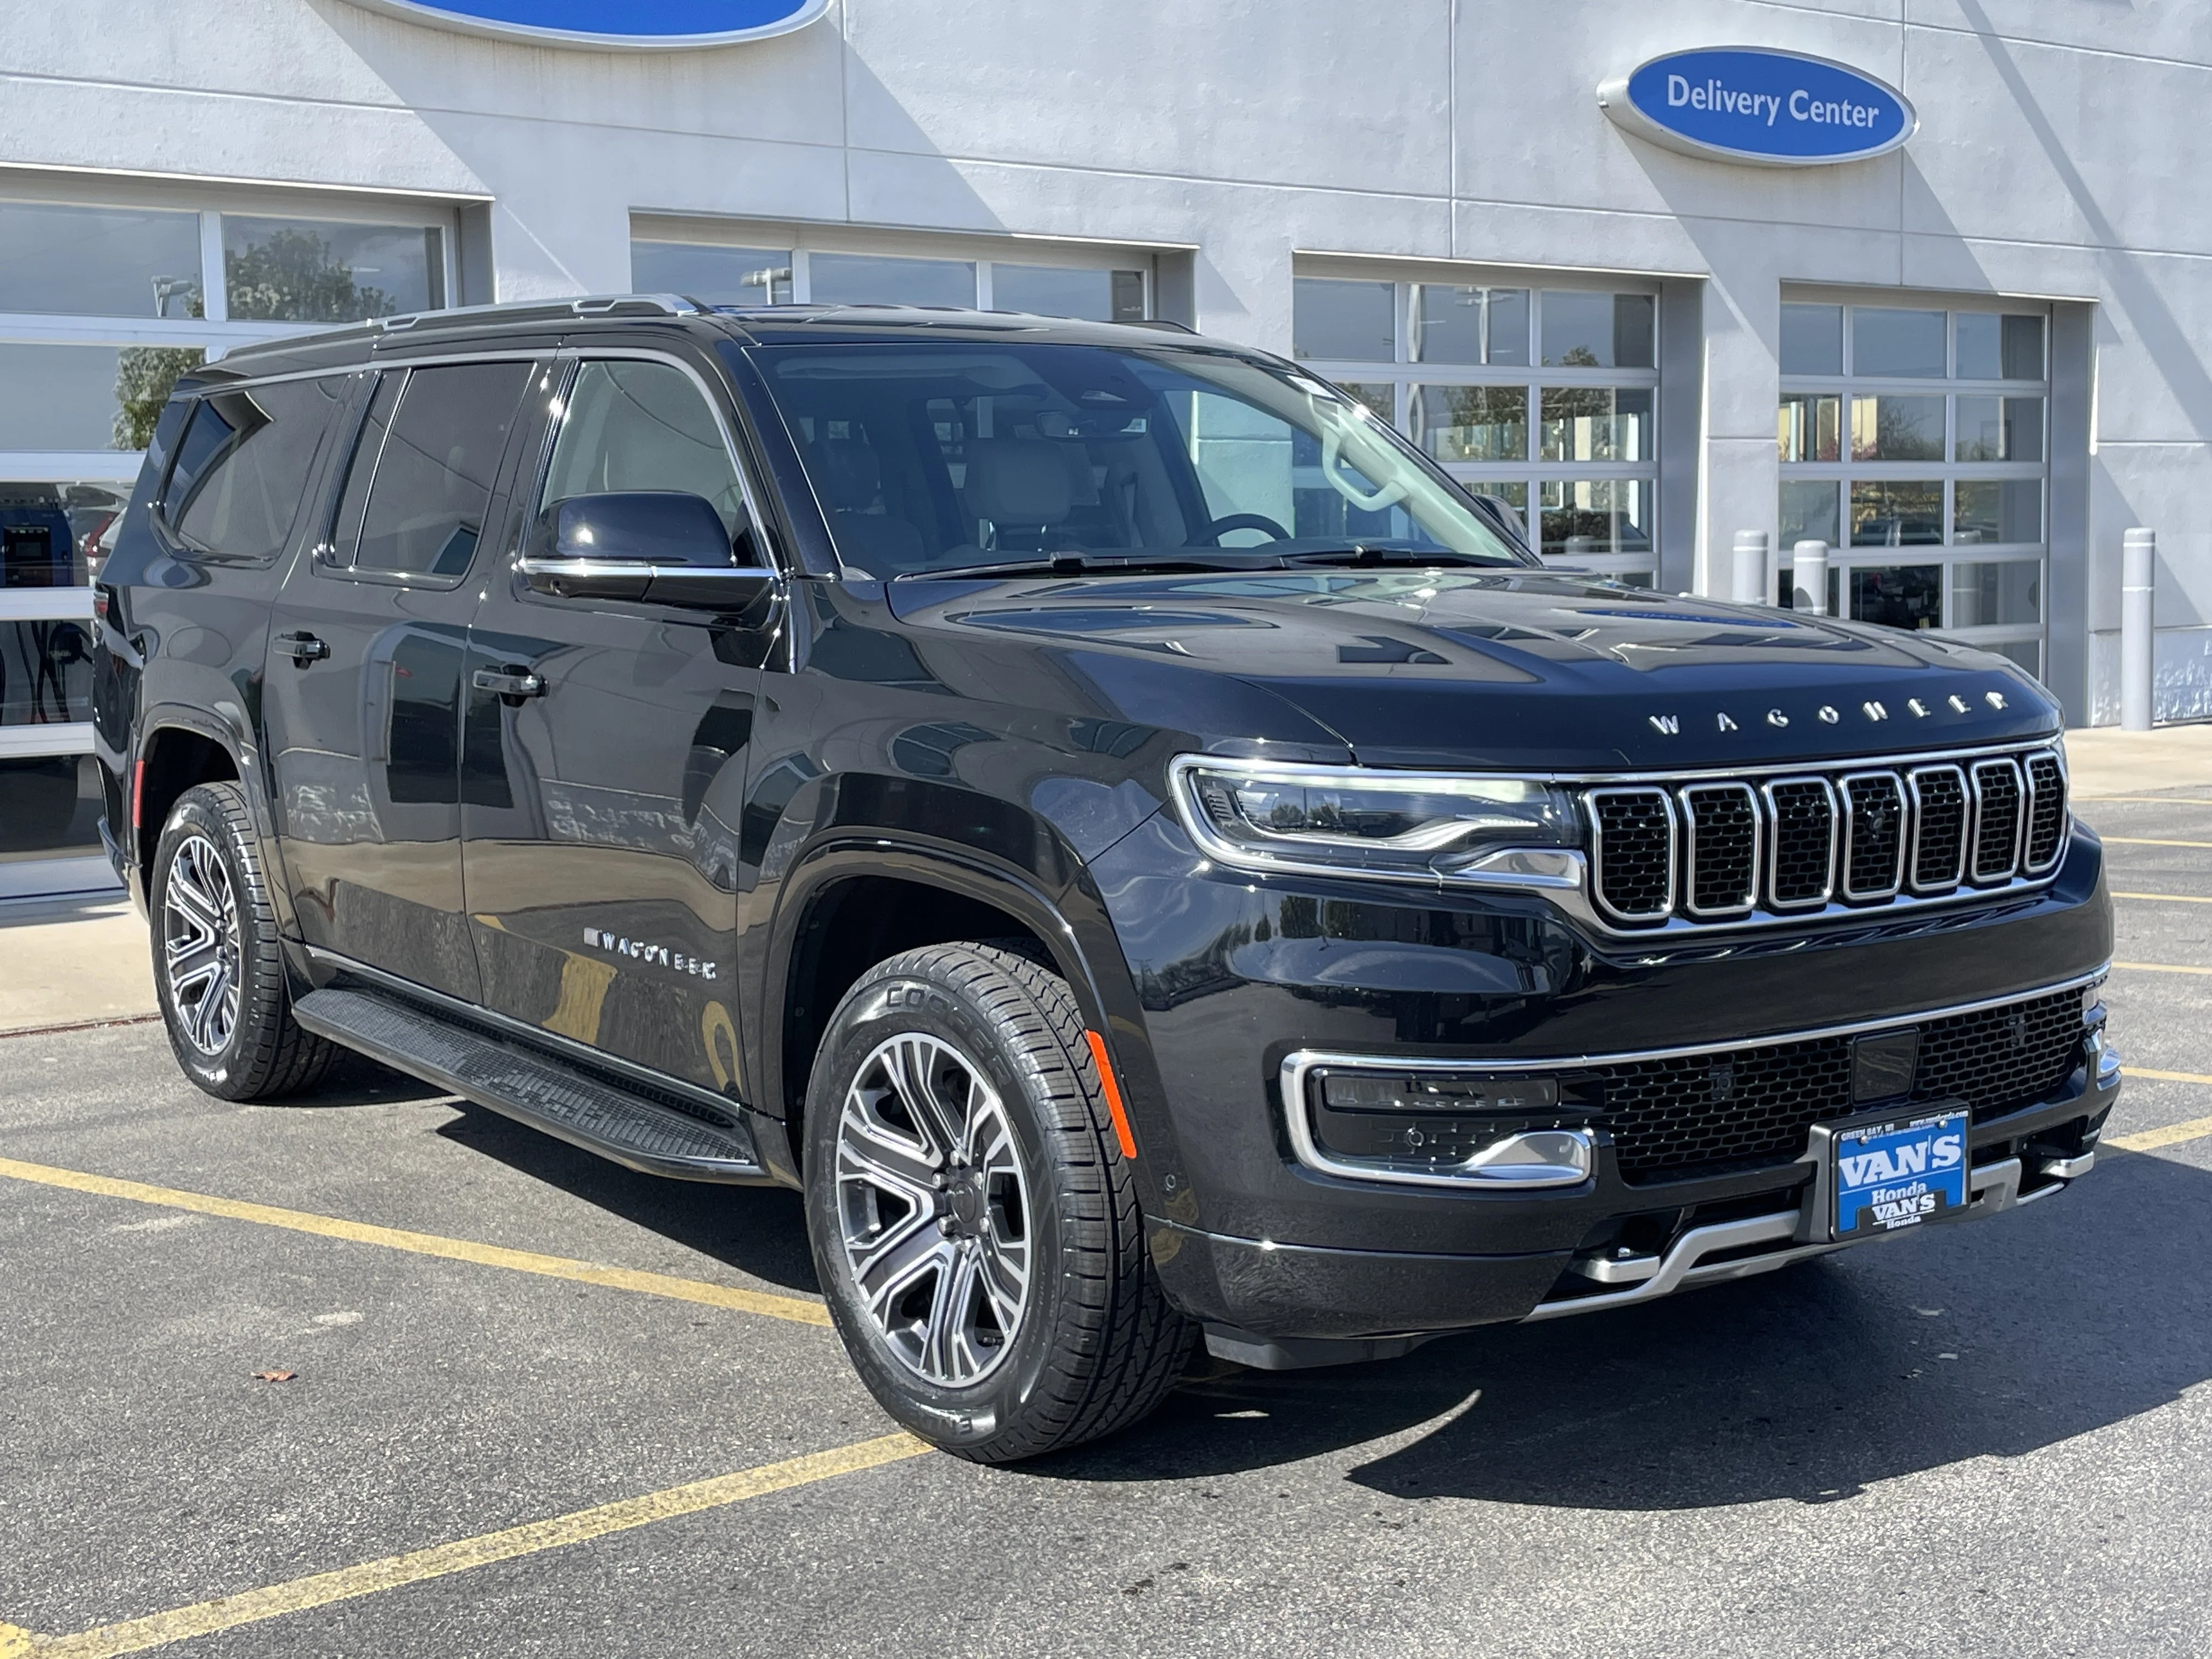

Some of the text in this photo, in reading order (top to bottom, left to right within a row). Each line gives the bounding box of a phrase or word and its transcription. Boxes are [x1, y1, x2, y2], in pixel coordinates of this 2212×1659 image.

[1668, 74, 1880, 128] Delivery Center
[1649, 691, 2008, 735] WAGONEER
[602, 932, 716, 980] WAGONEER
[1838, 1133, 1962, 1188] VAN'S
[1871, 1181, 1928, 1205] Honda
[1871, 1193, 1936, 1221] VAN'S
[1886, 1215, 1922, 1230] Honda
